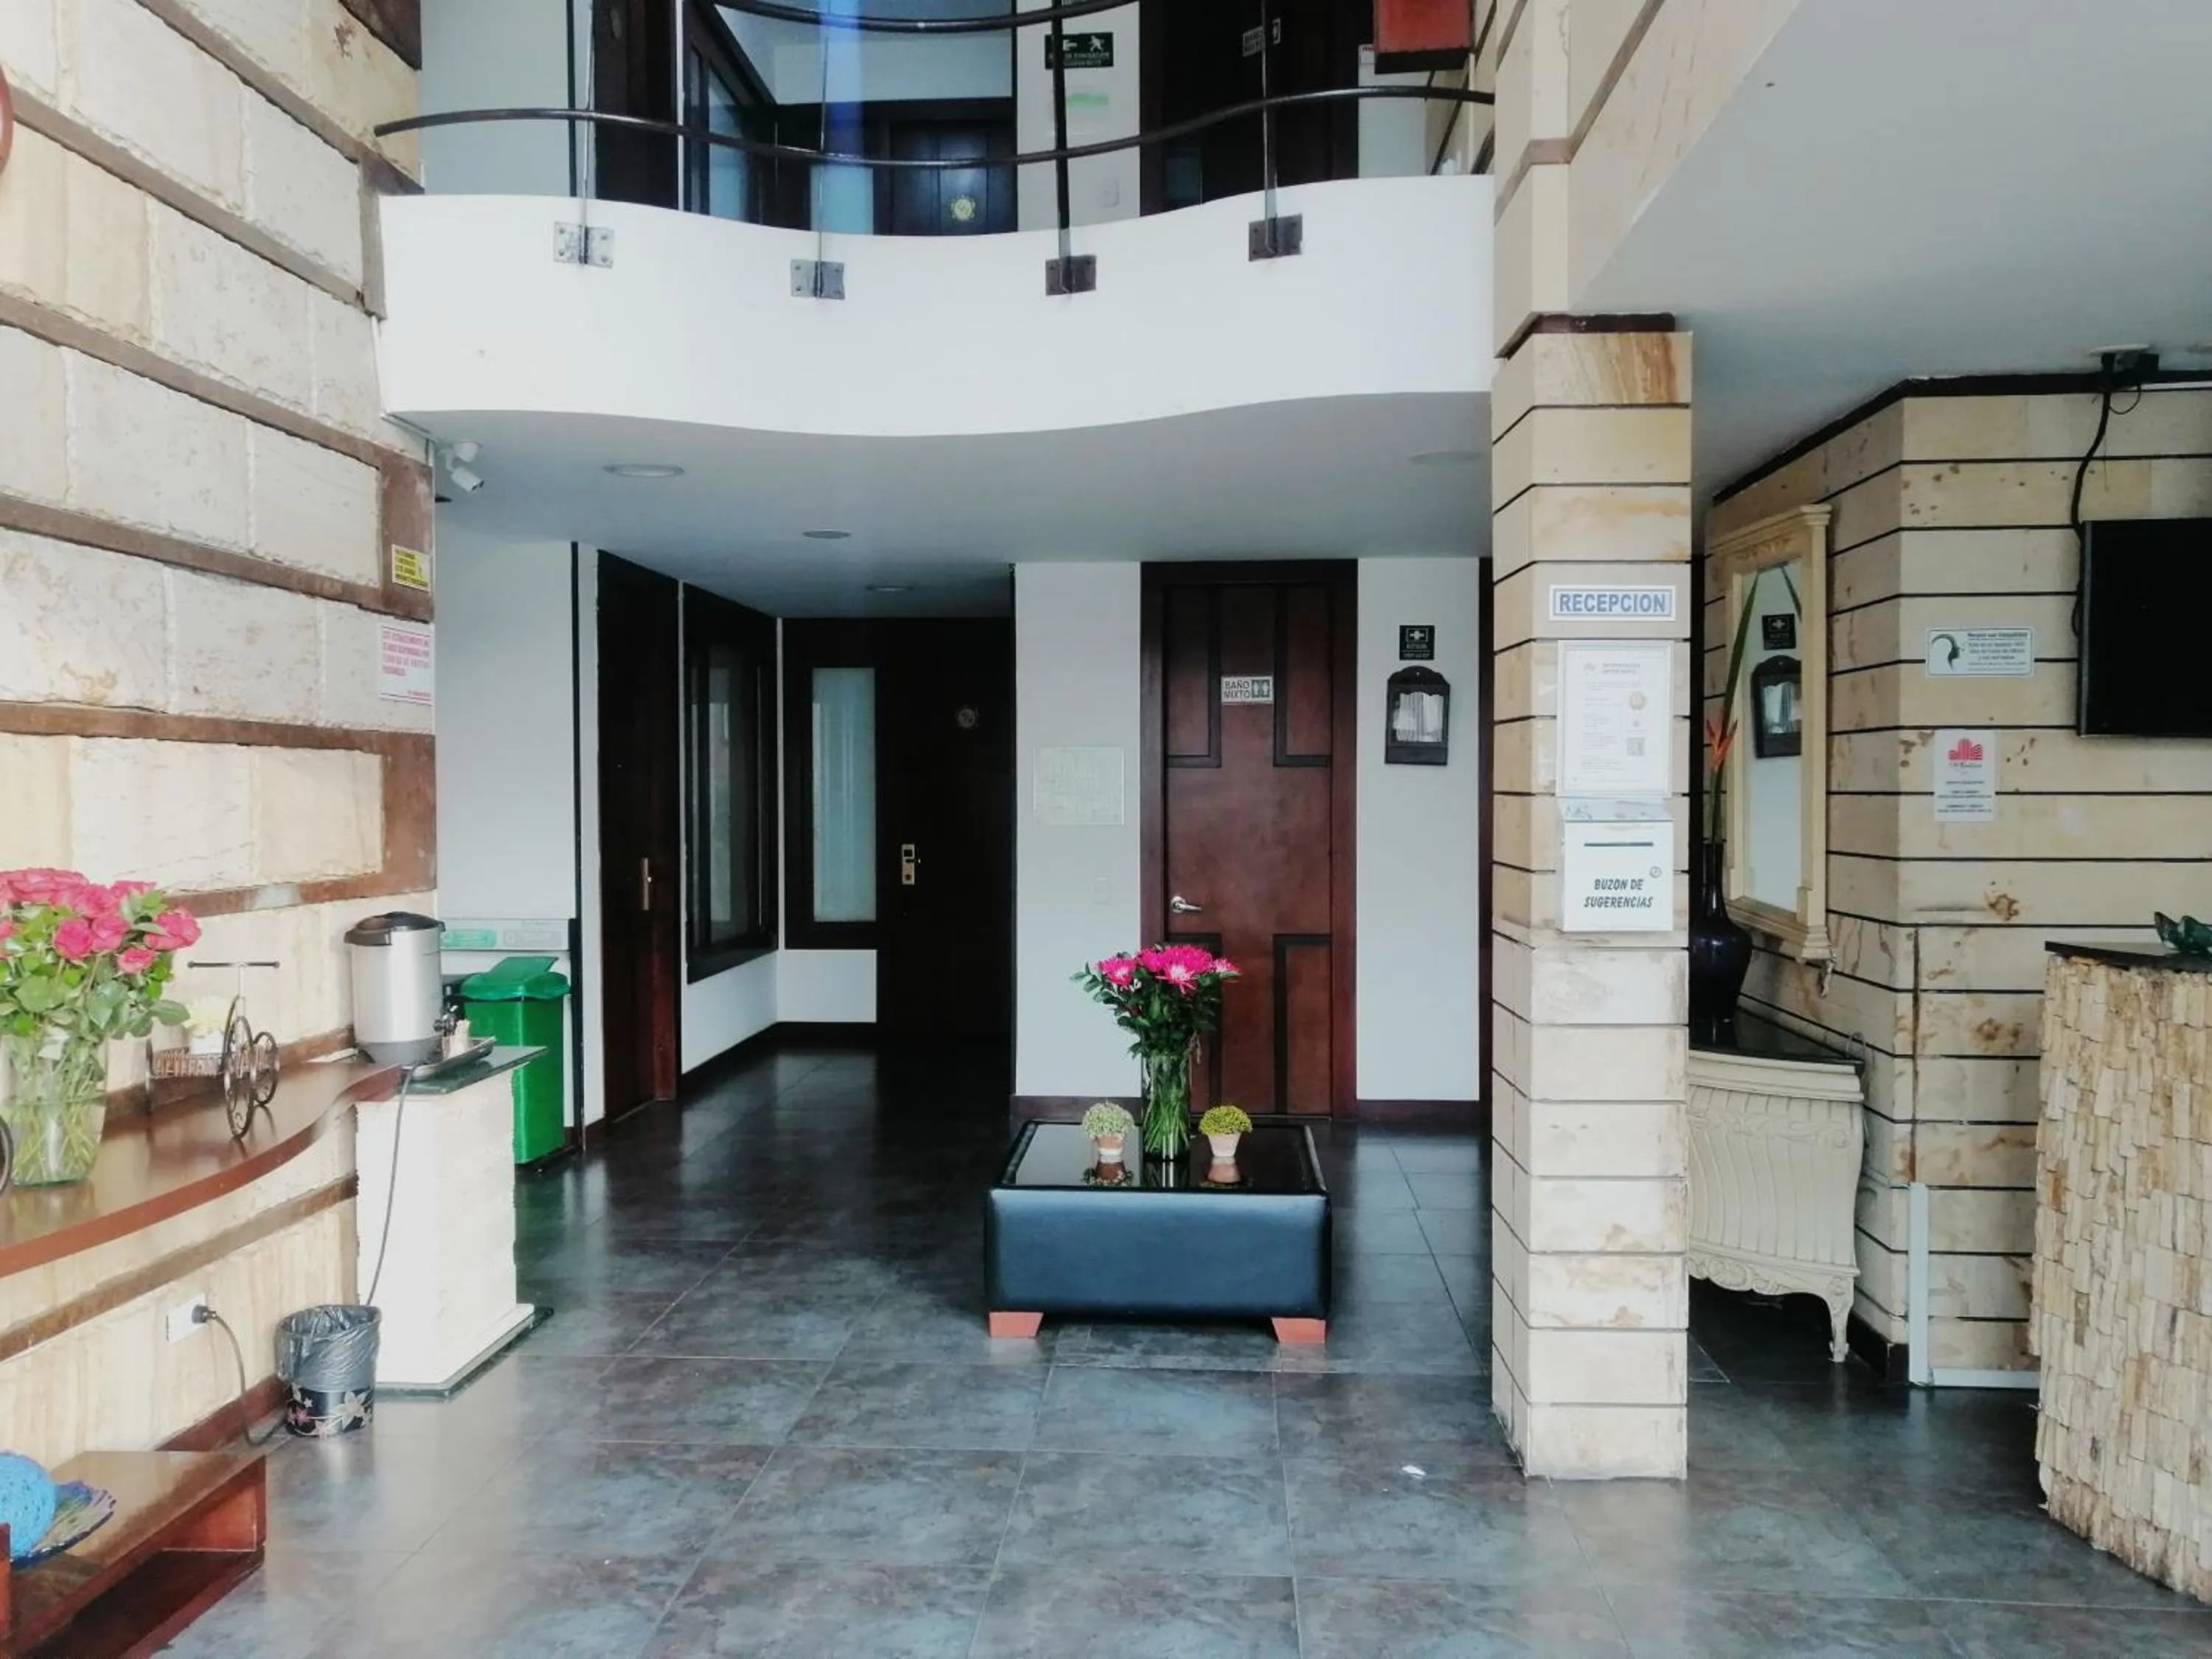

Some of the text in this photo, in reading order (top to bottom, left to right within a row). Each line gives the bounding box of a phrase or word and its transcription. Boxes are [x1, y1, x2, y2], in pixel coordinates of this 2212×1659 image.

[1559, 594, 1666, 612] RECEPCION
[1594, 878, 1644, 891] BUZON DE
[1583, 896, 1654, 908] SUGERENCIAS
